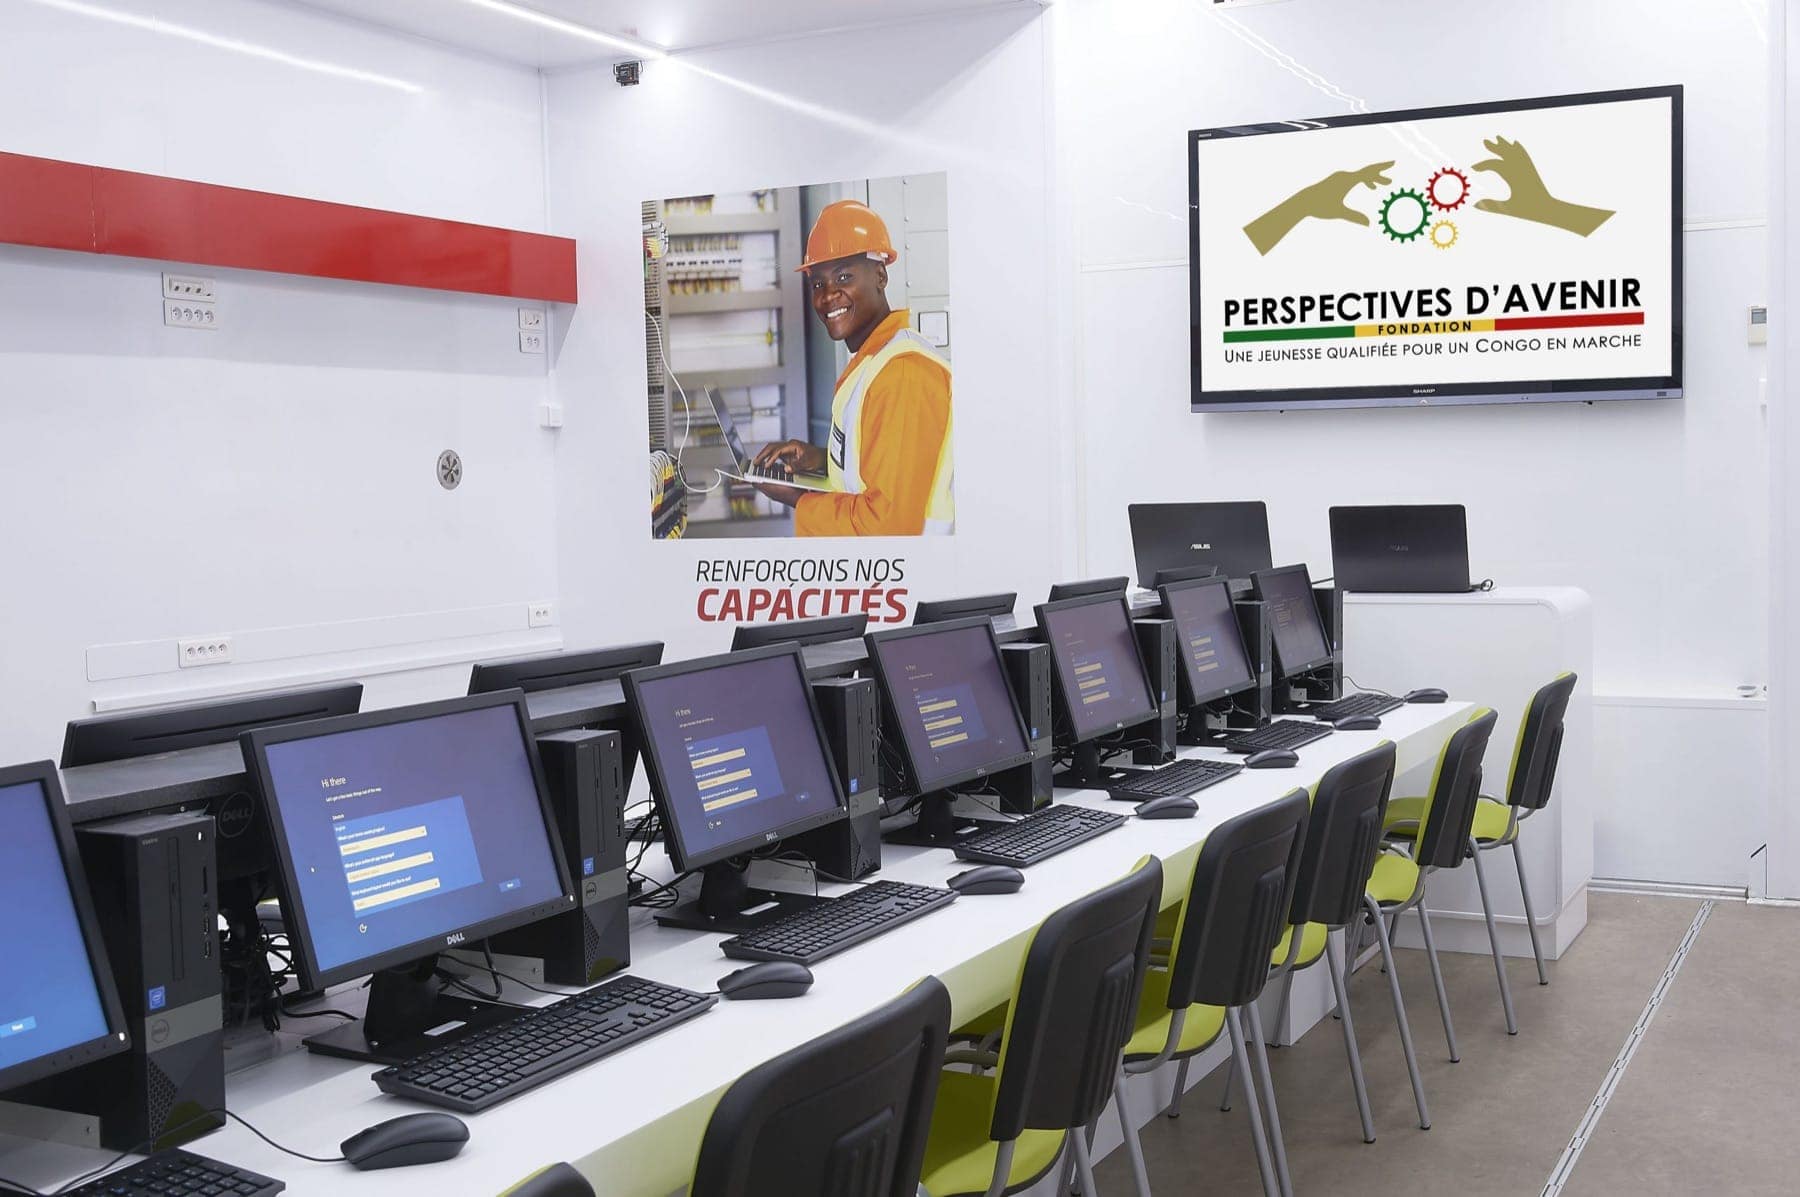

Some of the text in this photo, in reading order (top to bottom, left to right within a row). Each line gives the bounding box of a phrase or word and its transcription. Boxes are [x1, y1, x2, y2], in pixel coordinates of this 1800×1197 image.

[1224, 278, 1641, 327] PERSPECTIVES D'AVENIR
[1378, 321, 1472, 335] FONDATION
[1257, 347, 1322, 363] JEUNESSE
[1326, 341, 1398, 360] QUALIFIÉE
[1402, 342, 1443, 356] POUR
[1448, 341, 1469, 355] UN
[1547, 336, 1567, 351] EN
[1572, 333, 1642, 350] MARCHE
[696, 558, 905, 587] RENFORÇONS NOS
[696, 582, 908, 624] CAPACITÉS
[446, 932, 465, 945] DELL
